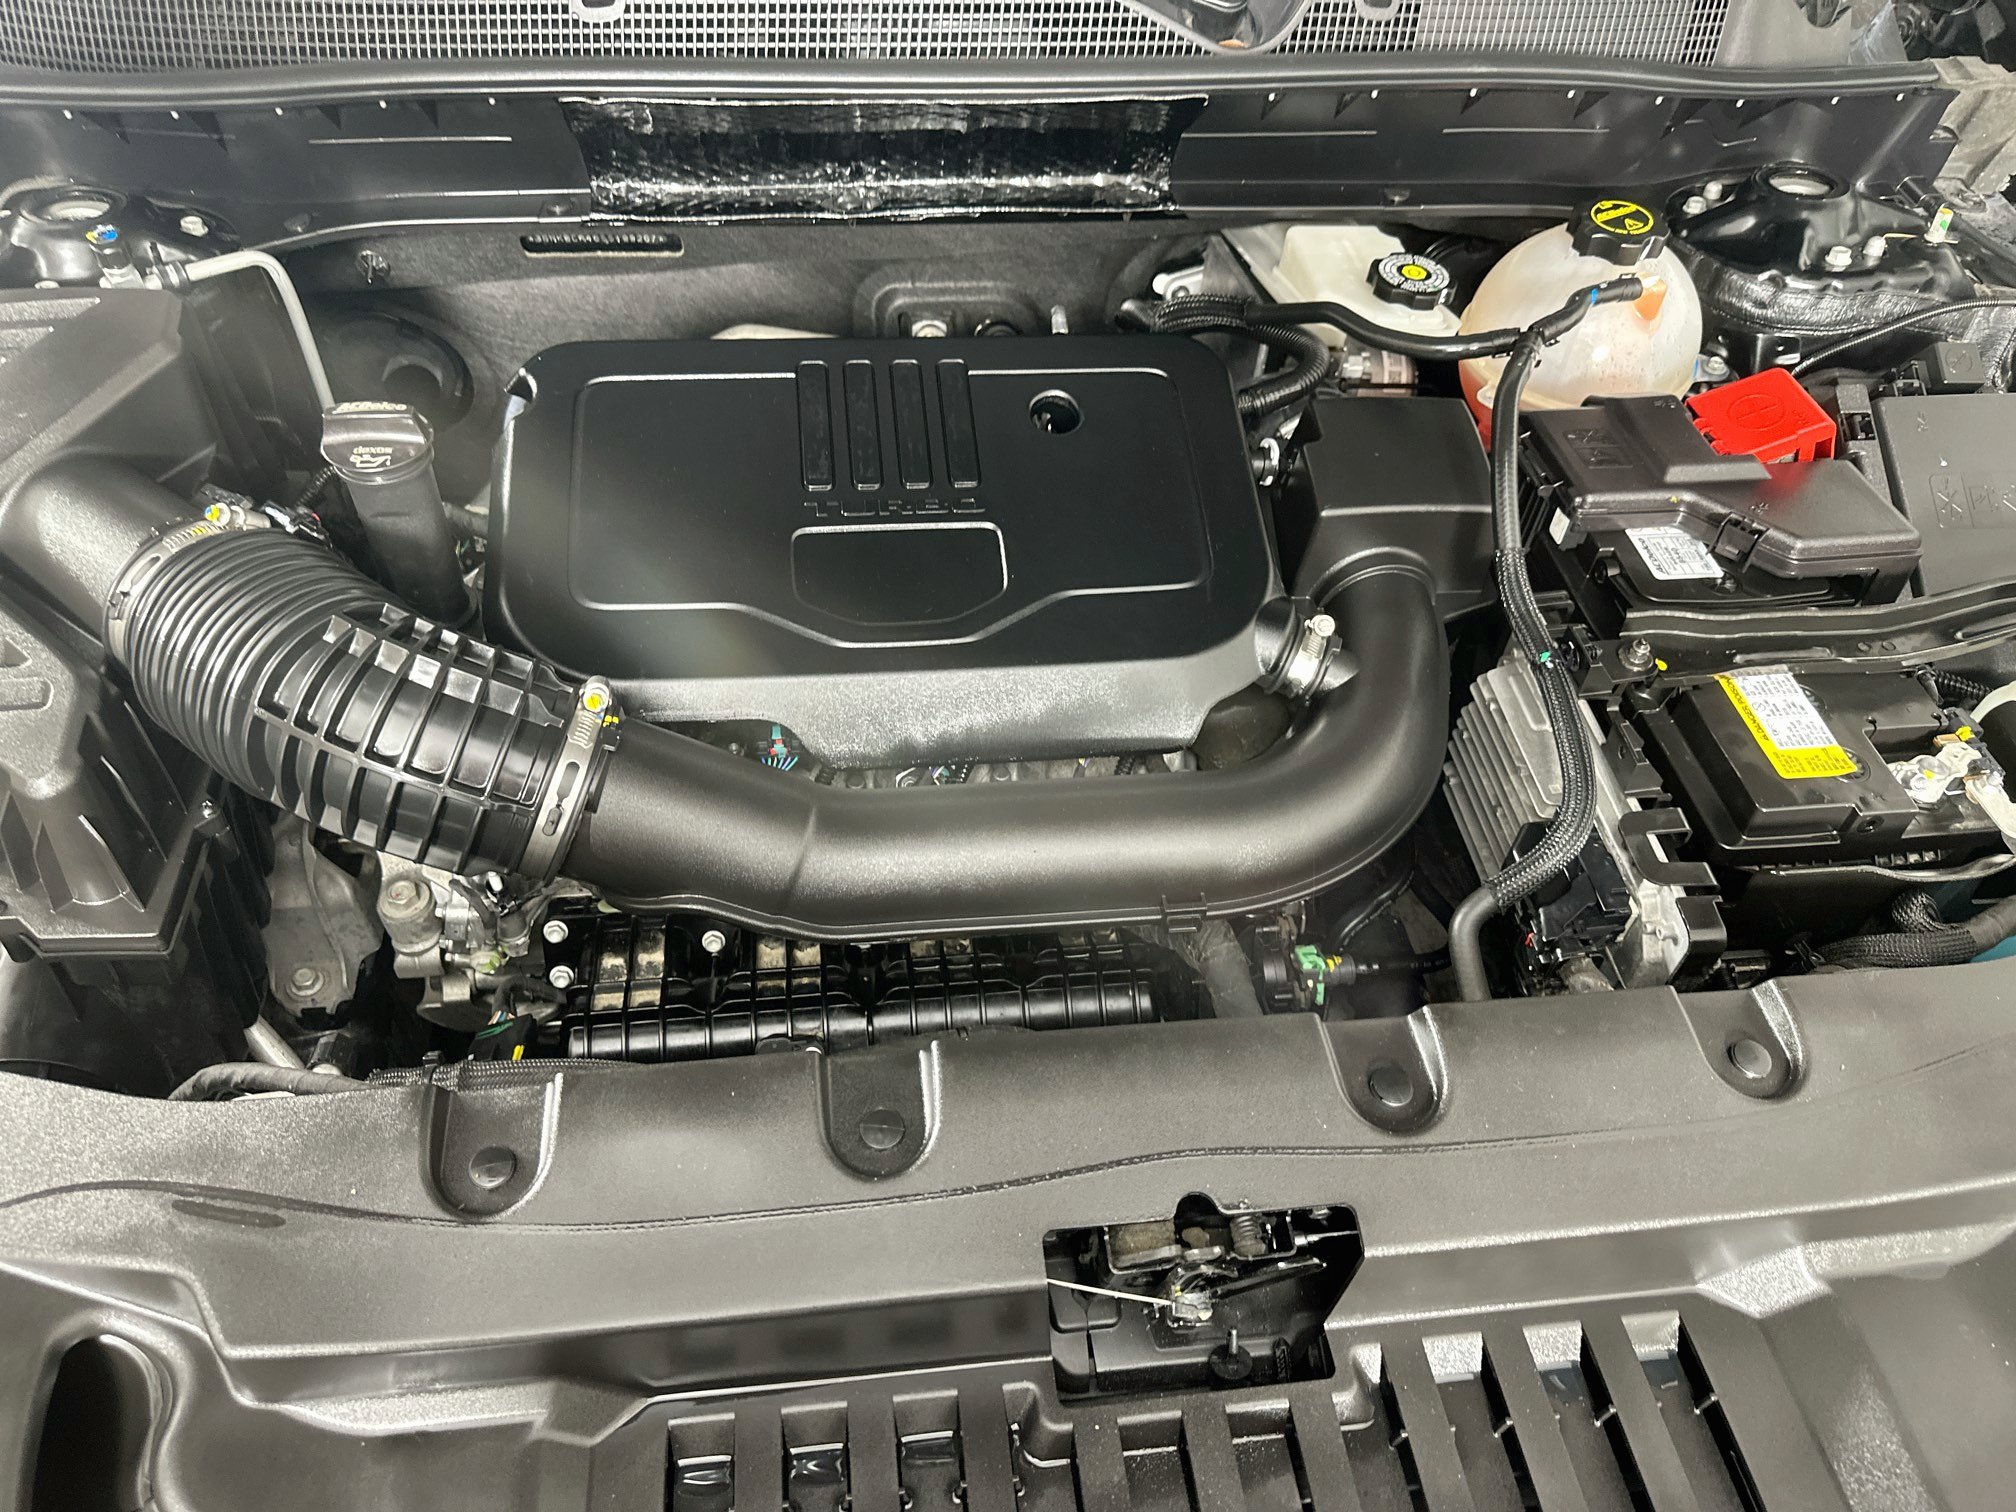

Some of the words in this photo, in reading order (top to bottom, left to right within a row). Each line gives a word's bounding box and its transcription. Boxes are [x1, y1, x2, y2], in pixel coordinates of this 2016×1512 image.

[332, 401, 408, 414] ACDelco
[803, 497, 987, 518] TURBO
[1742, 705, 1765, 734] DANGER
